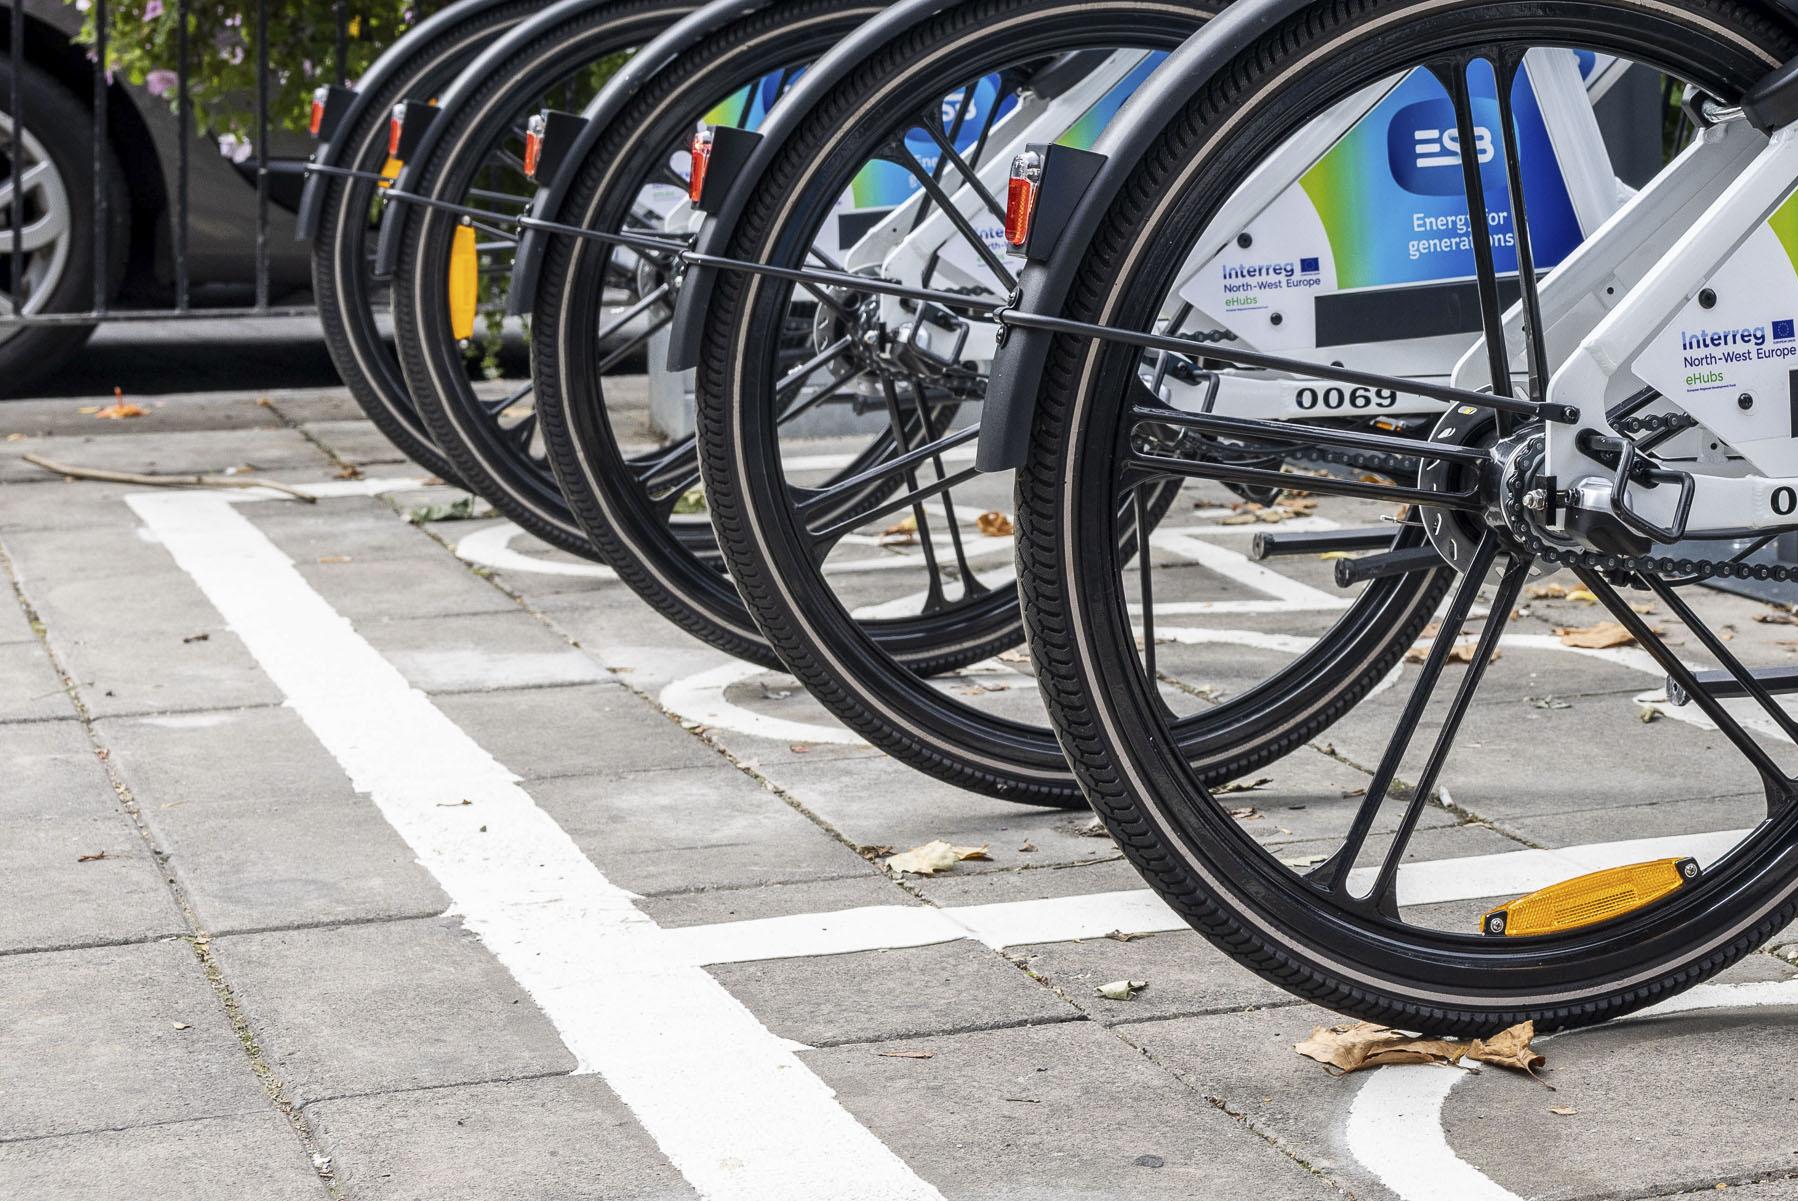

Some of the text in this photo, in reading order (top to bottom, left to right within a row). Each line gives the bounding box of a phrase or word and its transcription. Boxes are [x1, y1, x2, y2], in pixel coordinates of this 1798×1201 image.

[1414, 126, 1495, 168] ESB
[1412, 208, 1508, 233] Energ or
[1223, 262, 1295, 279] Interreg
[1224, 278, 1321, 293] North-West Europe
[1225, 296, 1258, 306] eHubs
[1681, 326, 1766, 350] Interreg
[1684, 345, 1797, 368] North-West Europe
[1685, 371, 1724, 385] eHubs
[1295, 387, 1397, 410] 0069
